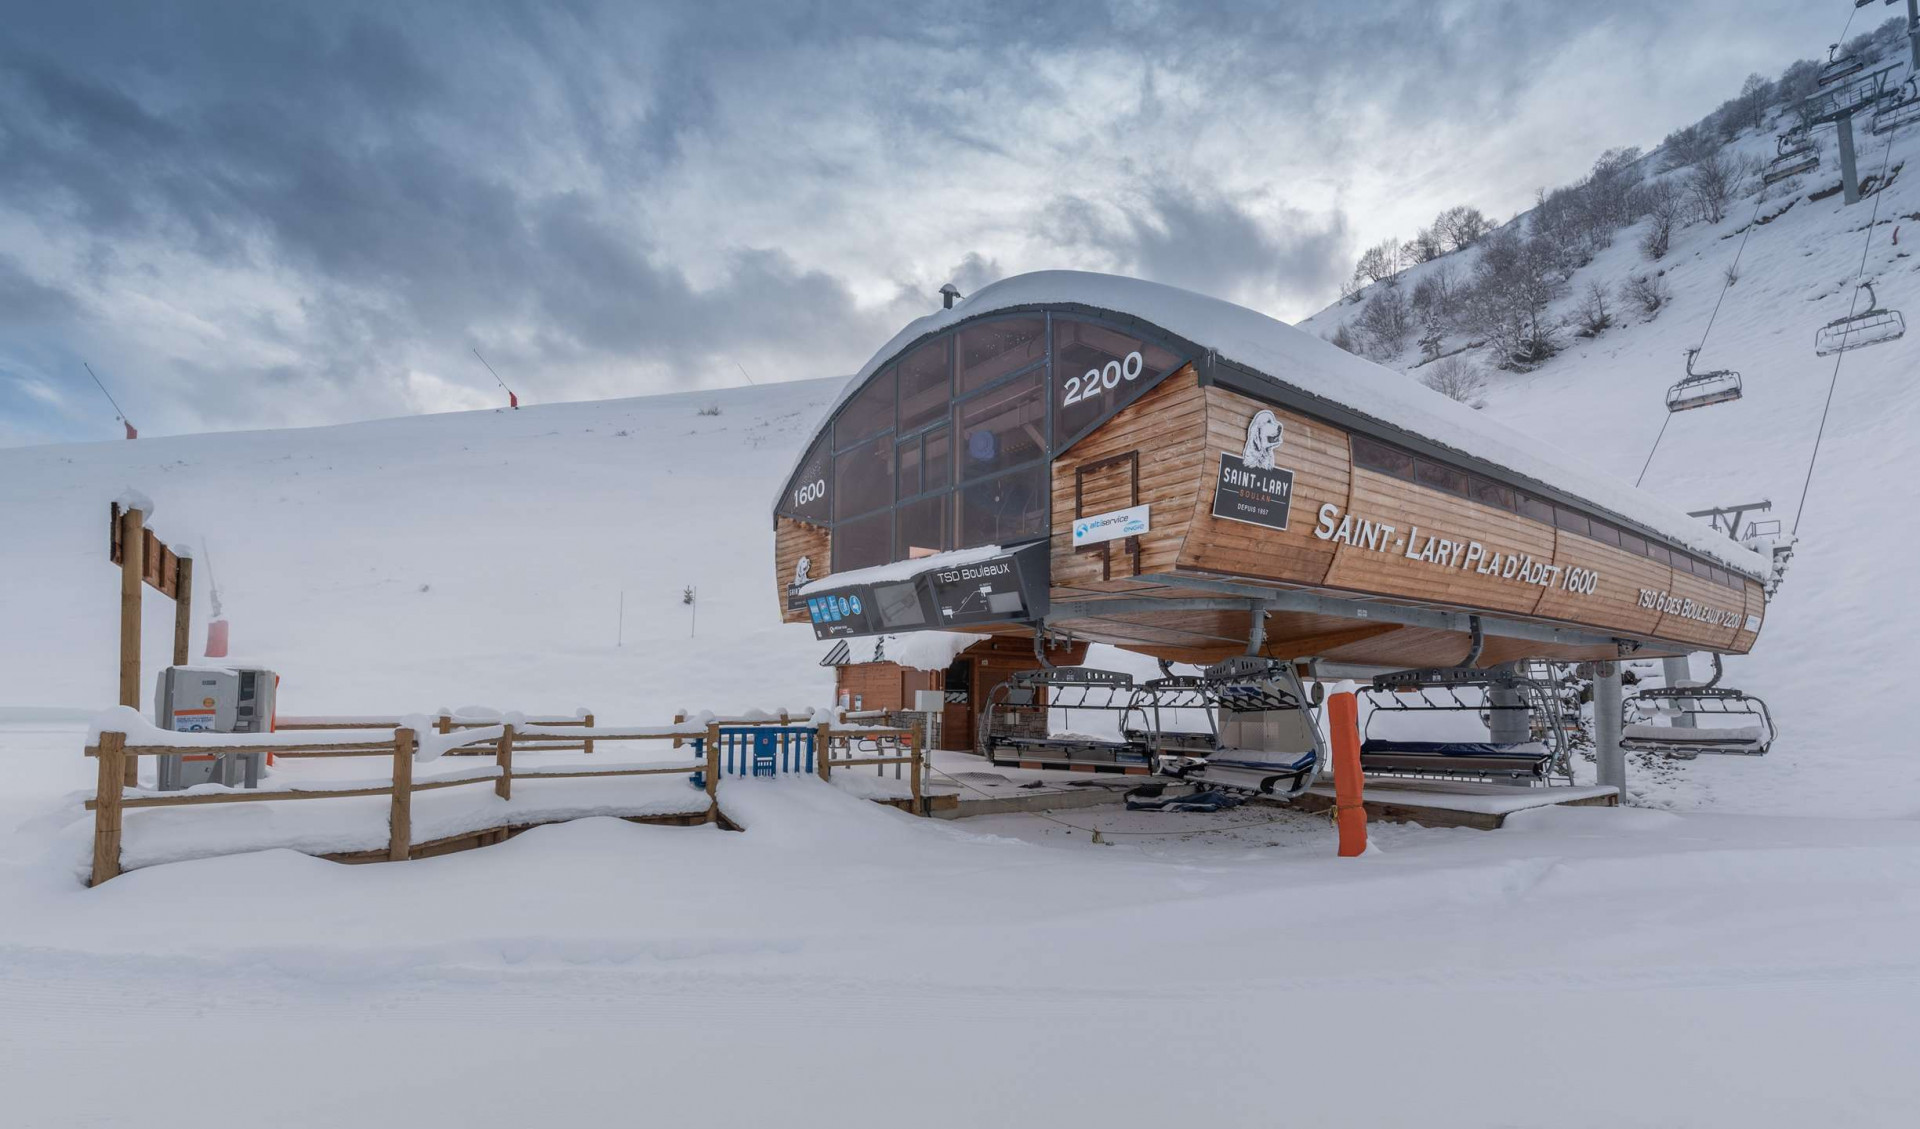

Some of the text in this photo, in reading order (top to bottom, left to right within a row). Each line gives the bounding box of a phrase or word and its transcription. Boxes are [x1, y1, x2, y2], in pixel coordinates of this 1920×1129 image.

[1064, 351, 1143, 407] 2200
[794, 479, 825, 508] 1600
[1223, 467, 1289, 497] SAINT LARY
[1239, 489, 1272, 503] SOULAN
[1090, 515, 1129, 530] altiservice
[1237, 503, 1256, 513] DEPUIS
[1314, 503, 1396, 552] SAINT
[1405, 526, 1465, 568] LARY
[1463, 541, 1500, 576] PLA
[1562, 565, 1598, 595] 1600
[937, 563, 1011, 584] TSD Bouleaux
[1637, 589, 1657, 609] TSD
[1655, 591, 1667, 611] 6
[1664, 597, 1682, 616] DES
[1680, 598, 1722, 625] BOULEAUX
[1723, 611, 1742, 628] 2200
